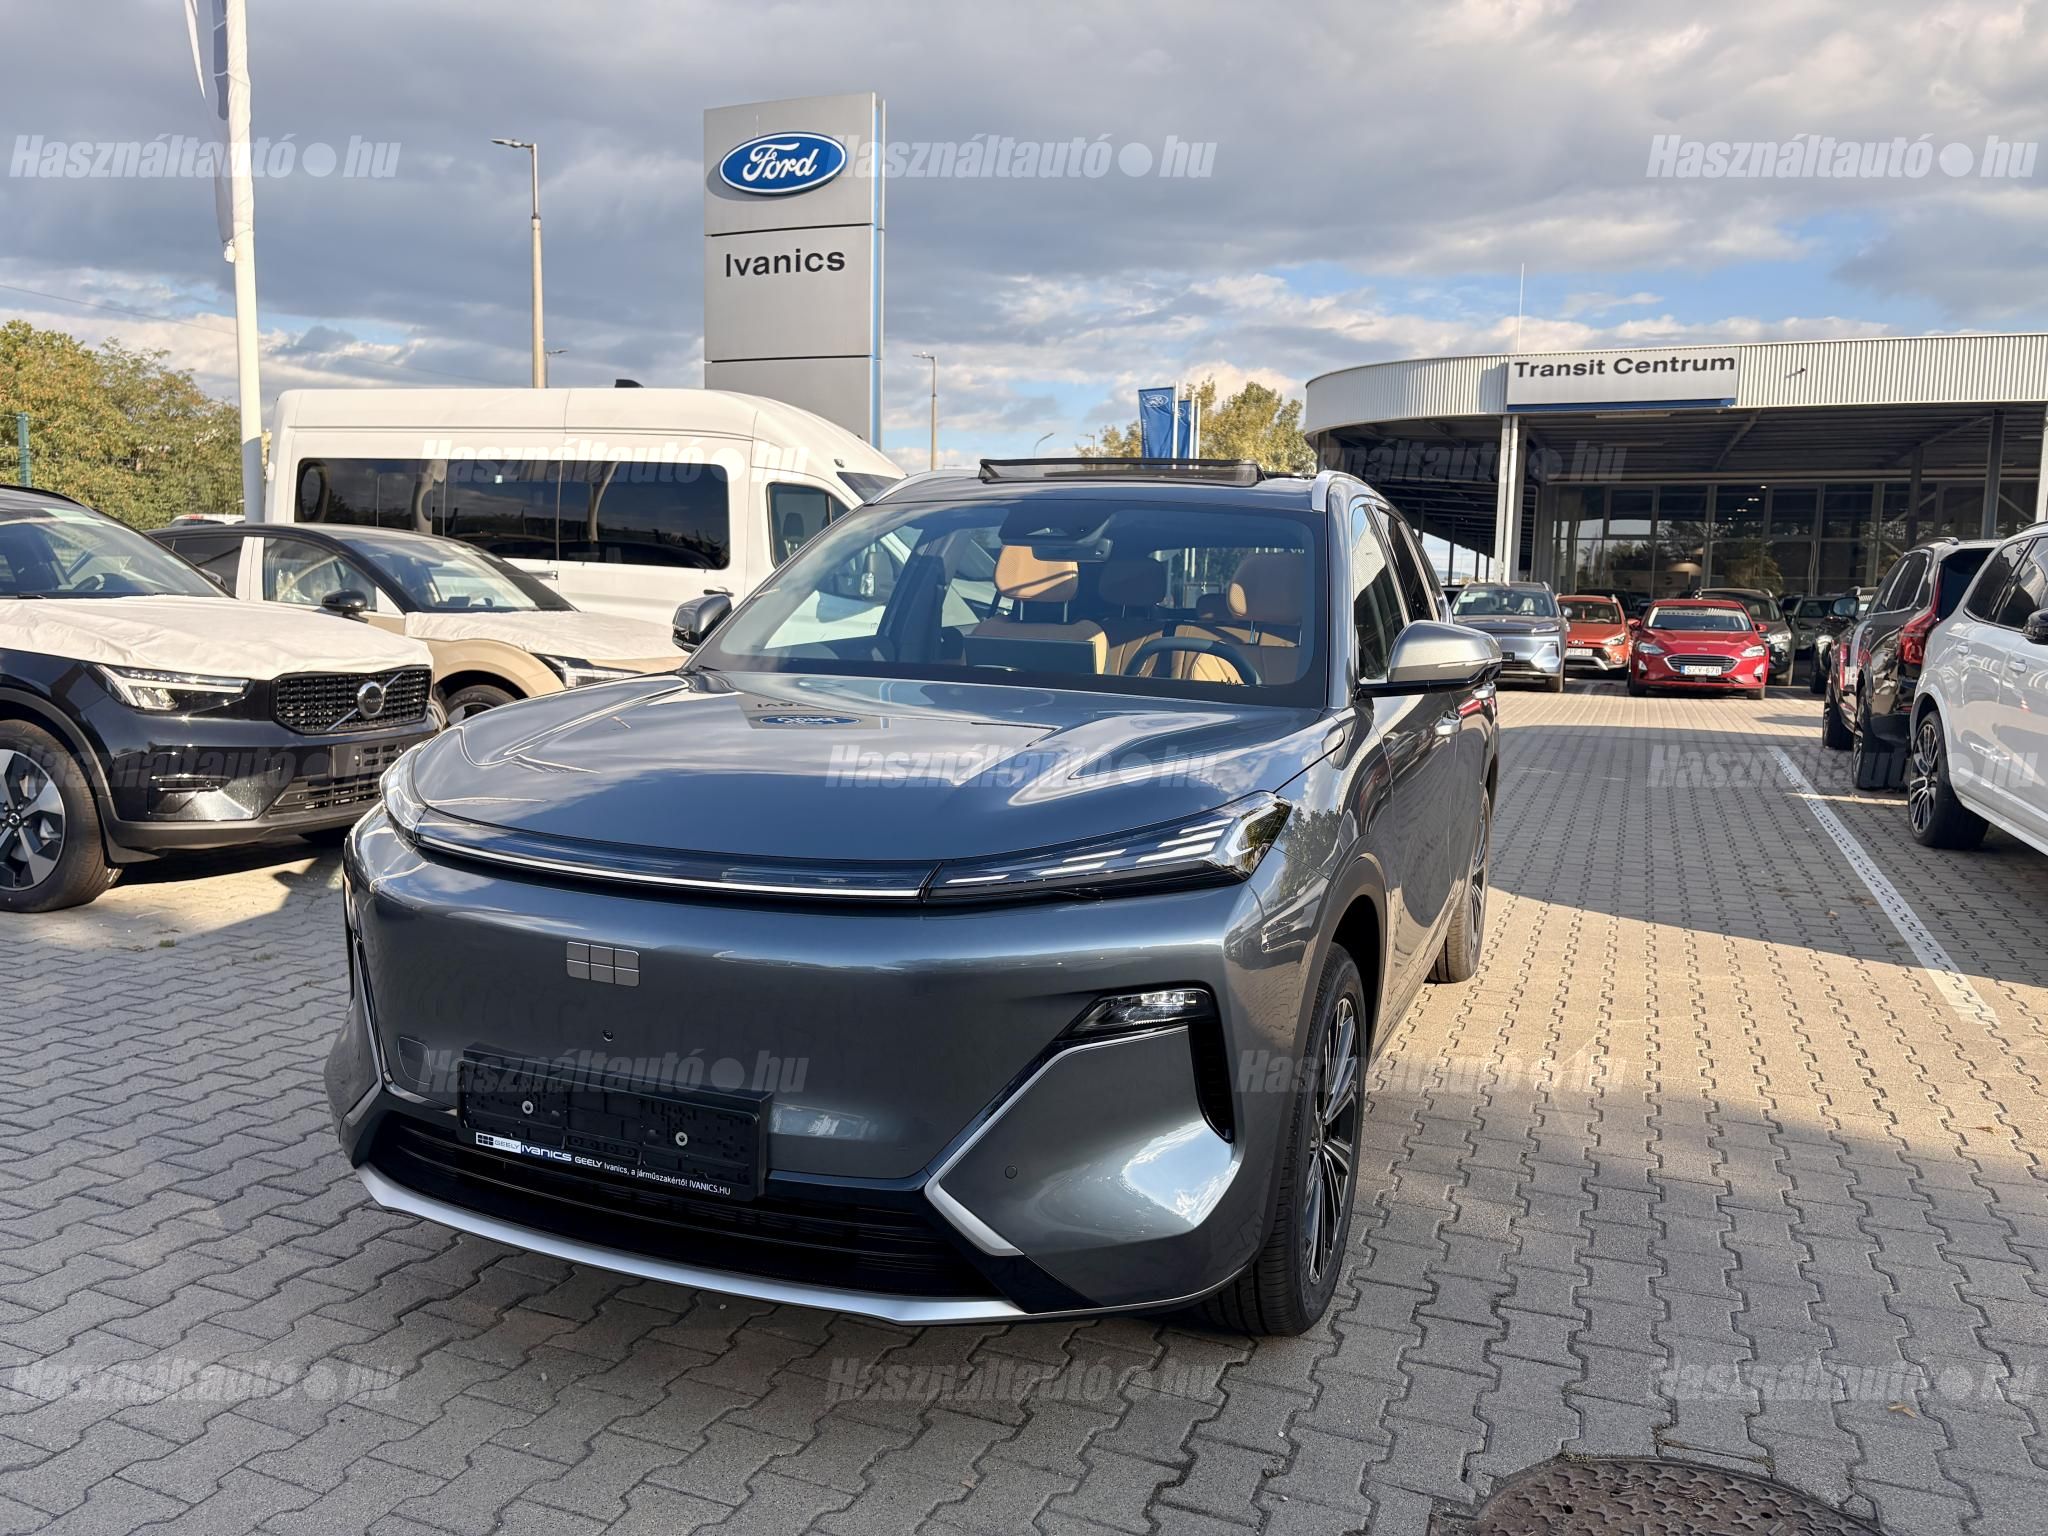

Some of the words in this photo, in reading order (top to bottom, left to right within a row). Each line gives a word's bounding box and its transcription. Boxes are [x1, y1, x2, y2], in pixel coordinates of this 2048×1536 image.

[743, 143, 819, 182] Ford
[726, 249, 845, 277] Ivanics
[1514, 359, 1605, 378] Transit
[1613, 356, 1735, 375] Centrum
[574, 1156, 603, 1168] GEELY
[689, 1179, 731, 1196] IVANICS.HU
